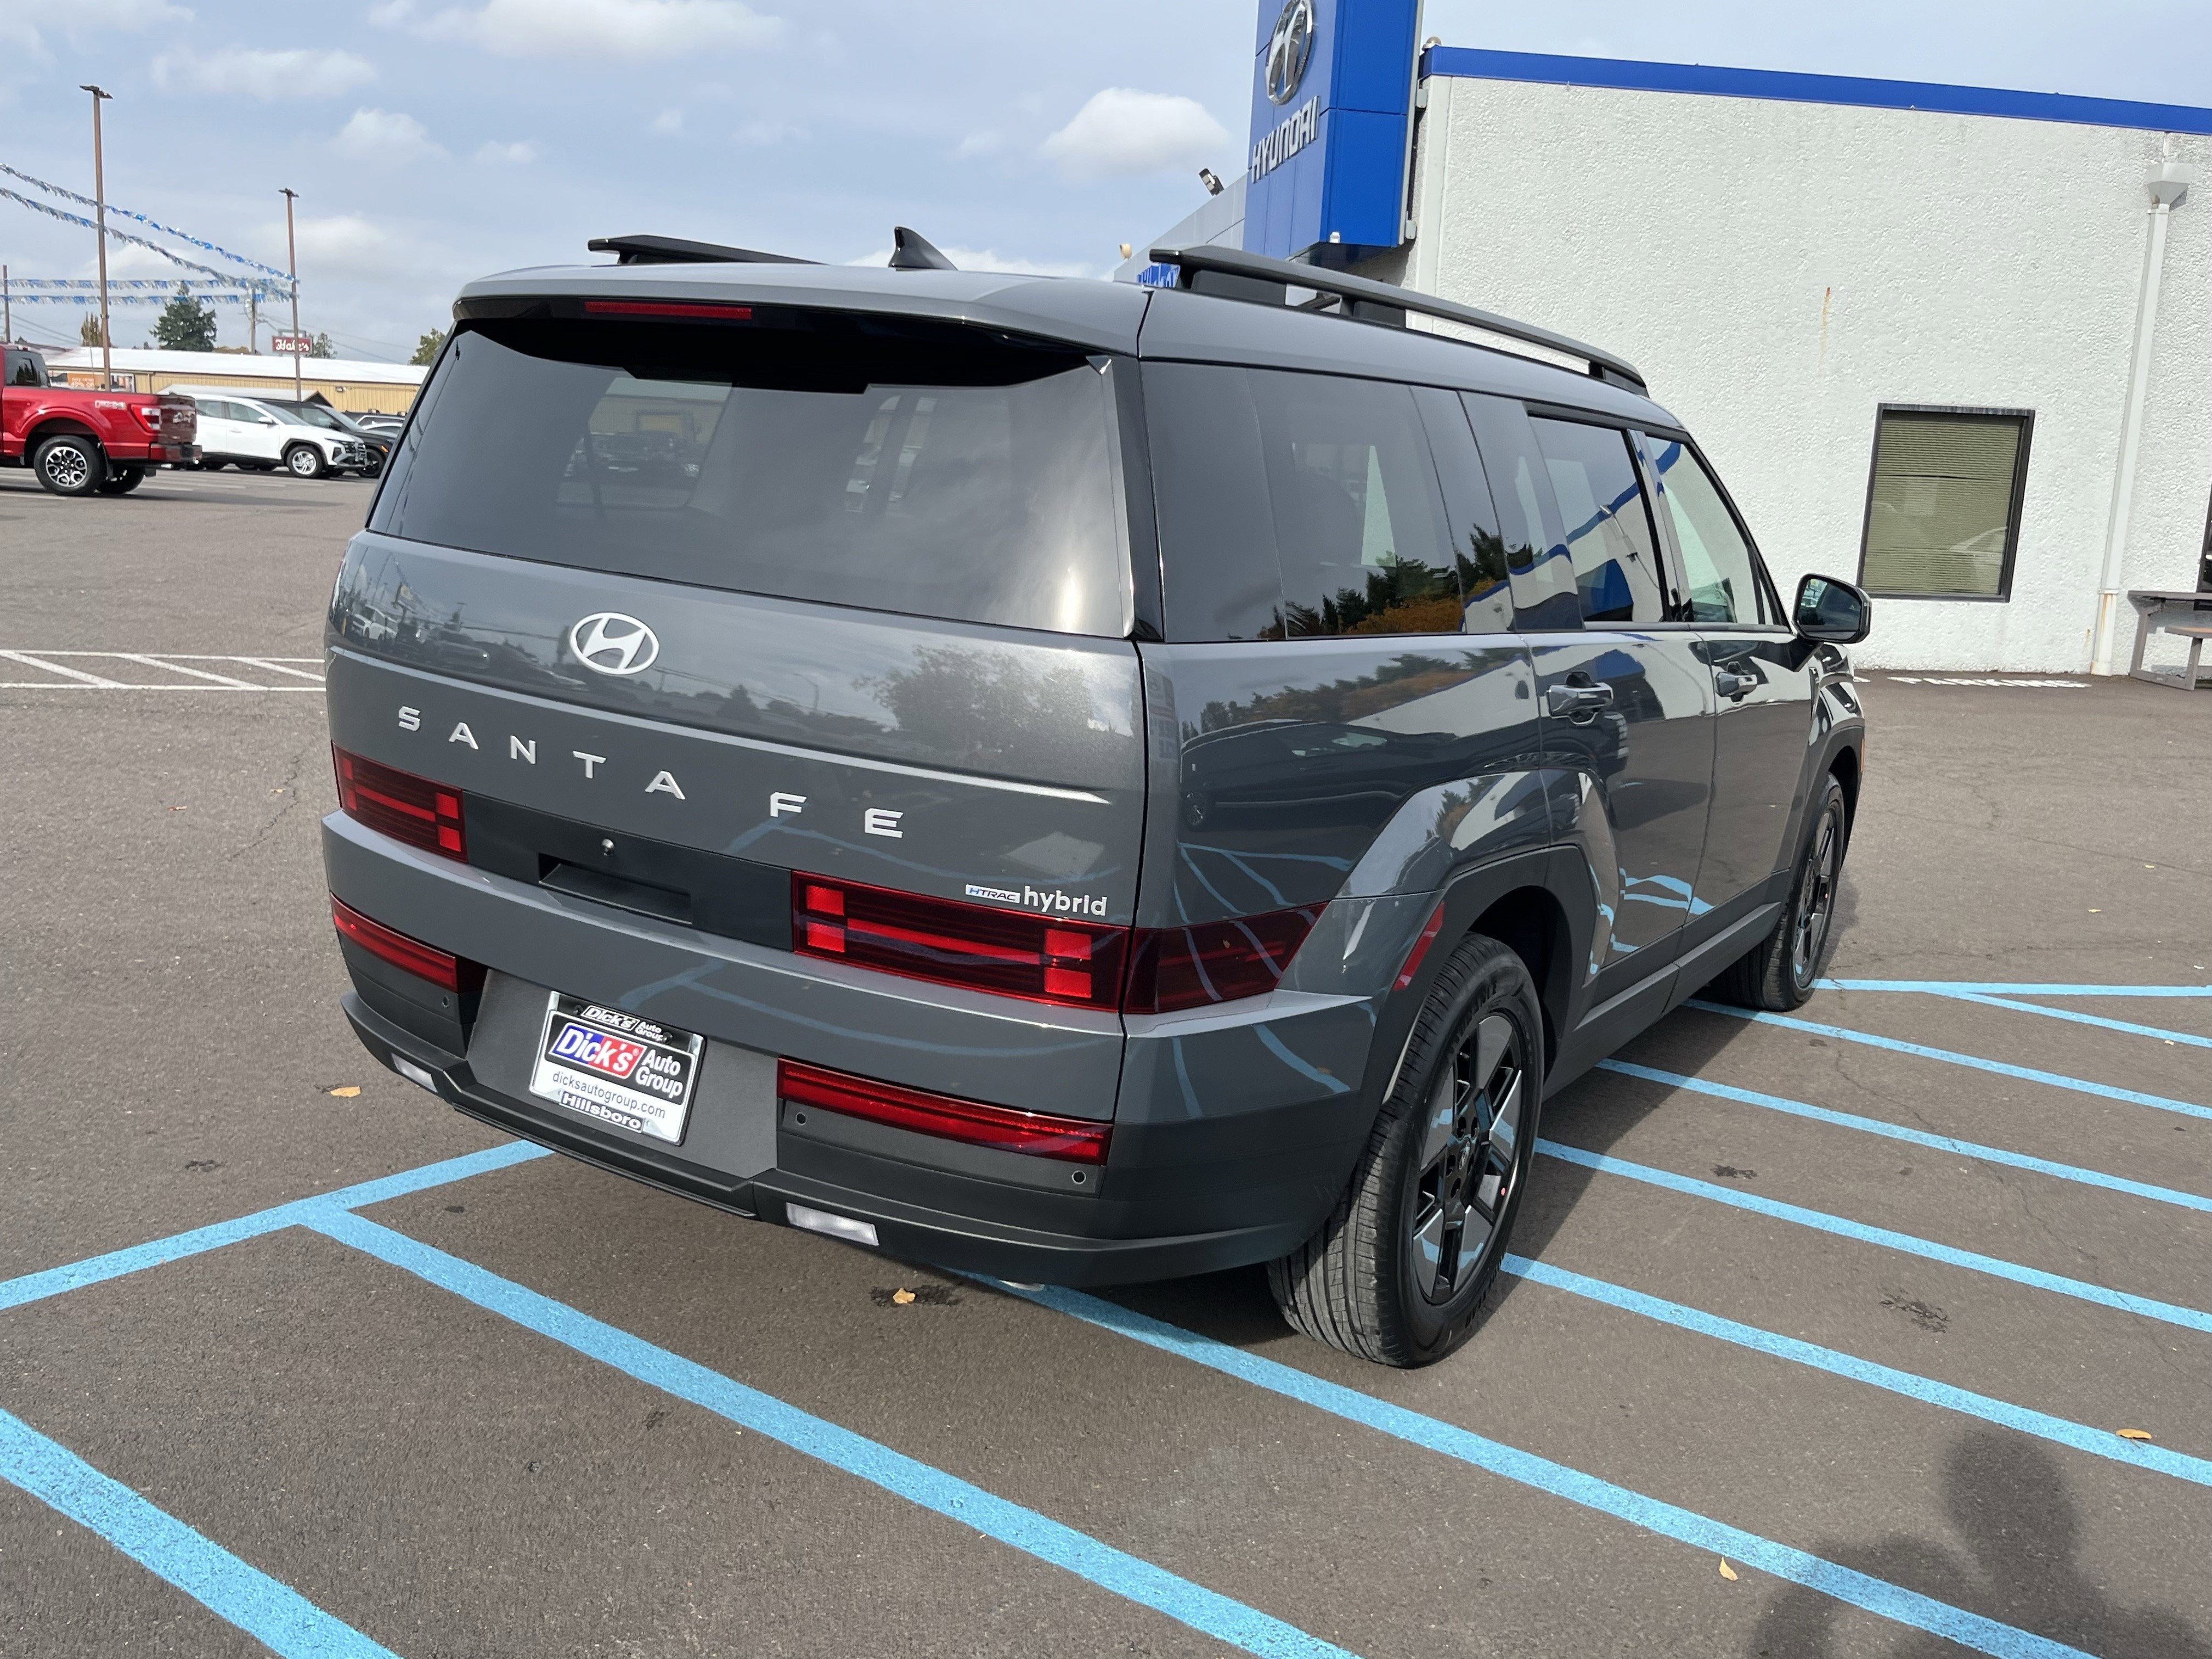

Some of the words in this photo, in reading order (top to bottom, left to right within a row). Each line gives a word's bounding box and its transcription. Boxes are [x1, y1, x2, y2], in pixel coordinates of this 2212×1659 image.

[1251, 95, 1319, 184] HYUNDAI
[398, 706, 686, 800] SANTA
[770, 792, 904, 838] FE
[969, 887, 1017, 901] HTRAC
[1024, 885, 1108, 916] hybrid
[584, 1006, 633, 1029] Dick's
[637, 1021, 662, 1034] Auto
[556, 1028, 633, 1073] Dick's
[641, 1048, 681, 1076] Auto
[552, 1071, 665, 1119] dicksautogroup.com
[635, 1065, 684, 1099] Group
[561, 1092, 642, 1130] Hillsboro
